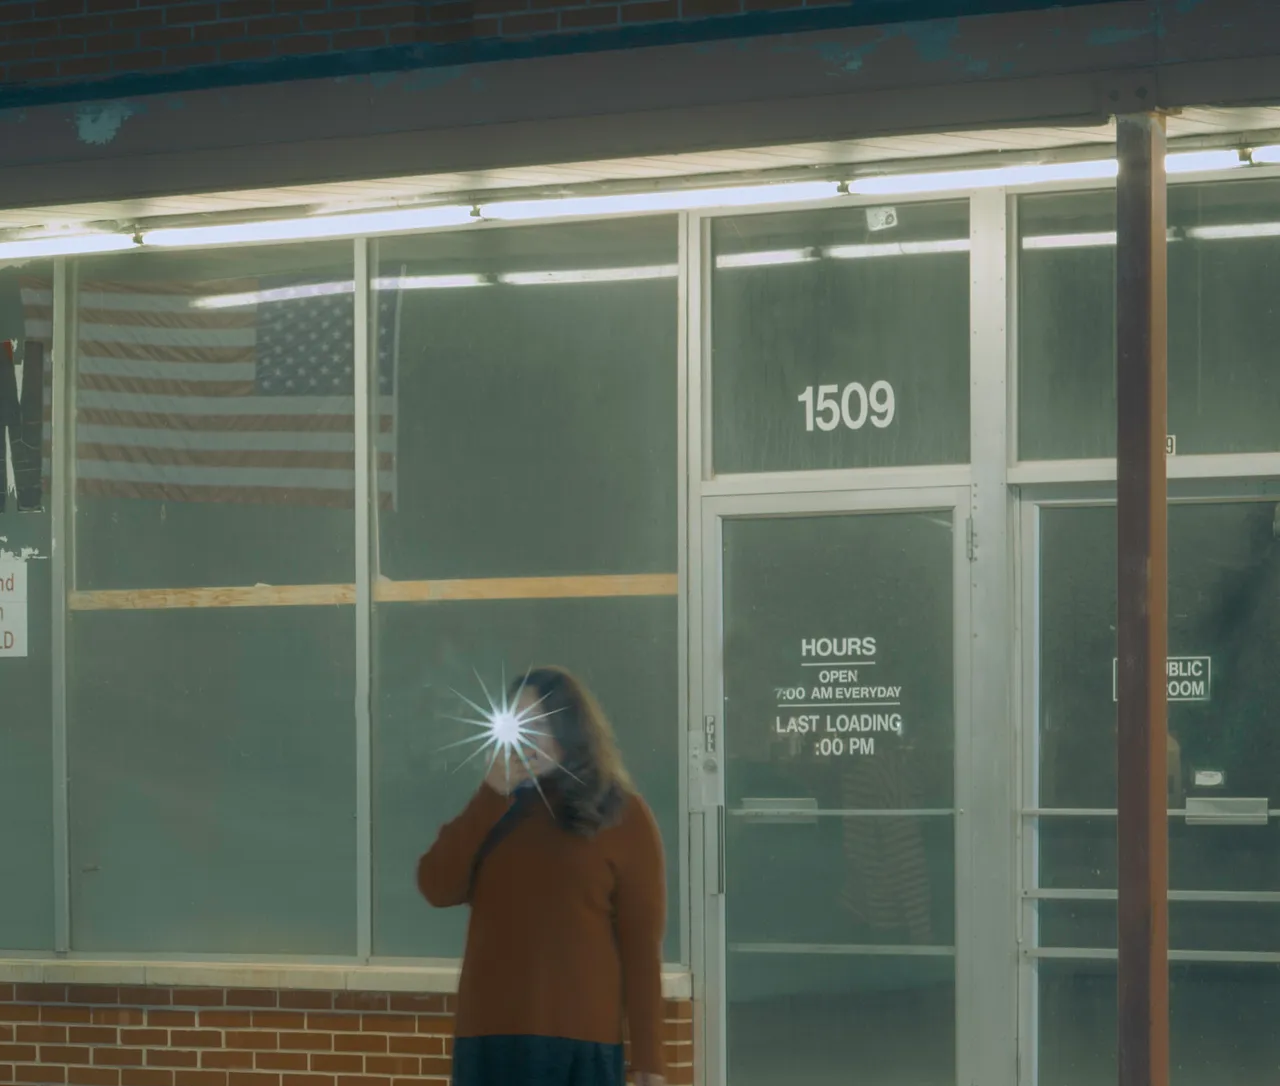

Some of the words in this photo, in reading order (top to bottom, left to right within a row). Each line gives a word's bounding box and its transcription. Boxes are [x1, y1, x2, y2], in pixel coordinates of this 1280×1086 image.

[797, 380, 895, 431] 1509
[801, 637, 876, 656] HOURS
[819, 670, 858, 683] OPEN
[1166, 661, 1203, 677] BLIC
[774, 687, 806, 700] 7:00
[811, 686, 833, 699] AM
[835, 686, 902, 699] EVERYDAY
[1167, 680, 1205, 696] OOM
[775, 714, 820, 733] LAST
[826, 713, 902, 732] LOADING
[706, 716, 715, 752] PULL
[849, 737, 875, 755] PM
